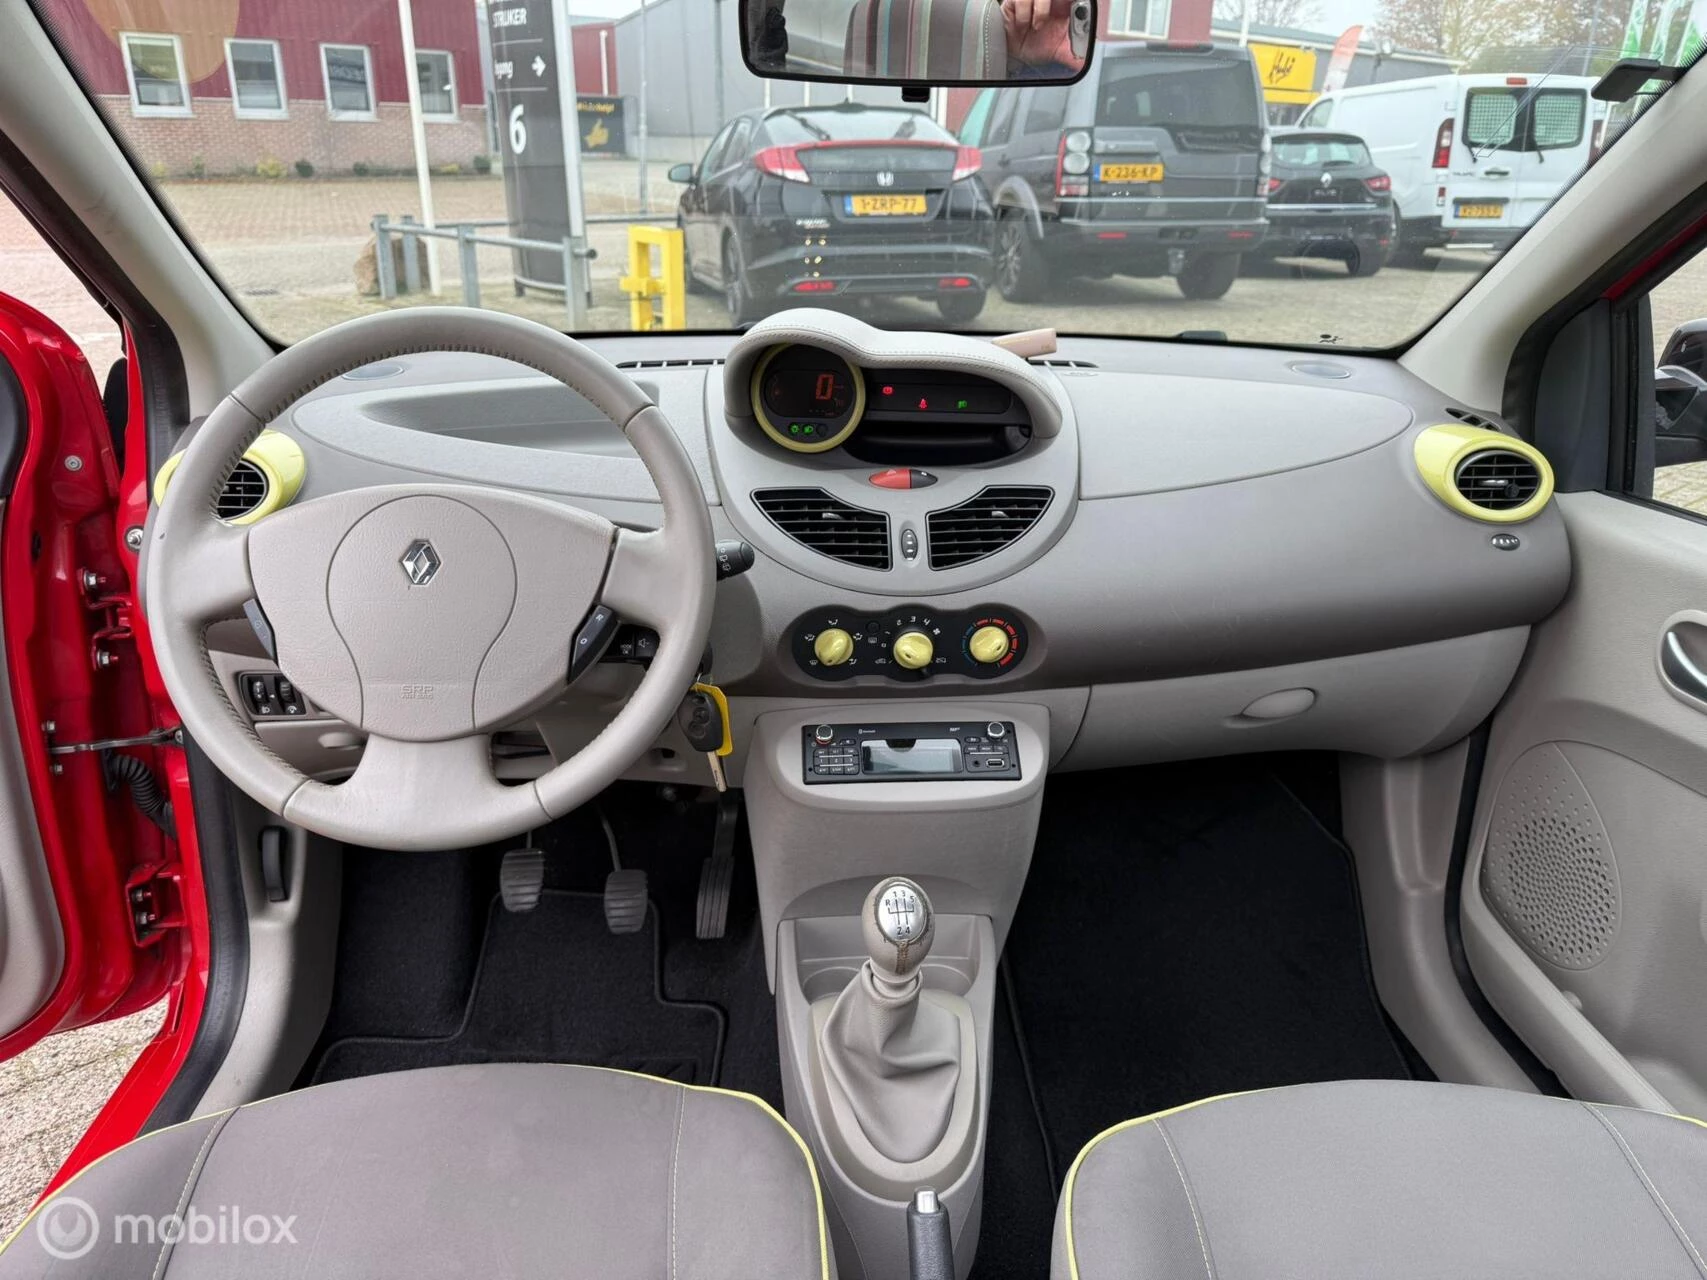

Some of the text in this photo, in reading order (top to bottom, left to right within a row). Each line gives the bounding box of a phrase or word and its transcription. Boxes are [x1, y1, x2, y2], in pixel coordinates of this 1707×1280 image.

[508, 104, 527, 154] 6
[815, 373, 834, 400] 0
[910, 615, 917, 623] 3
